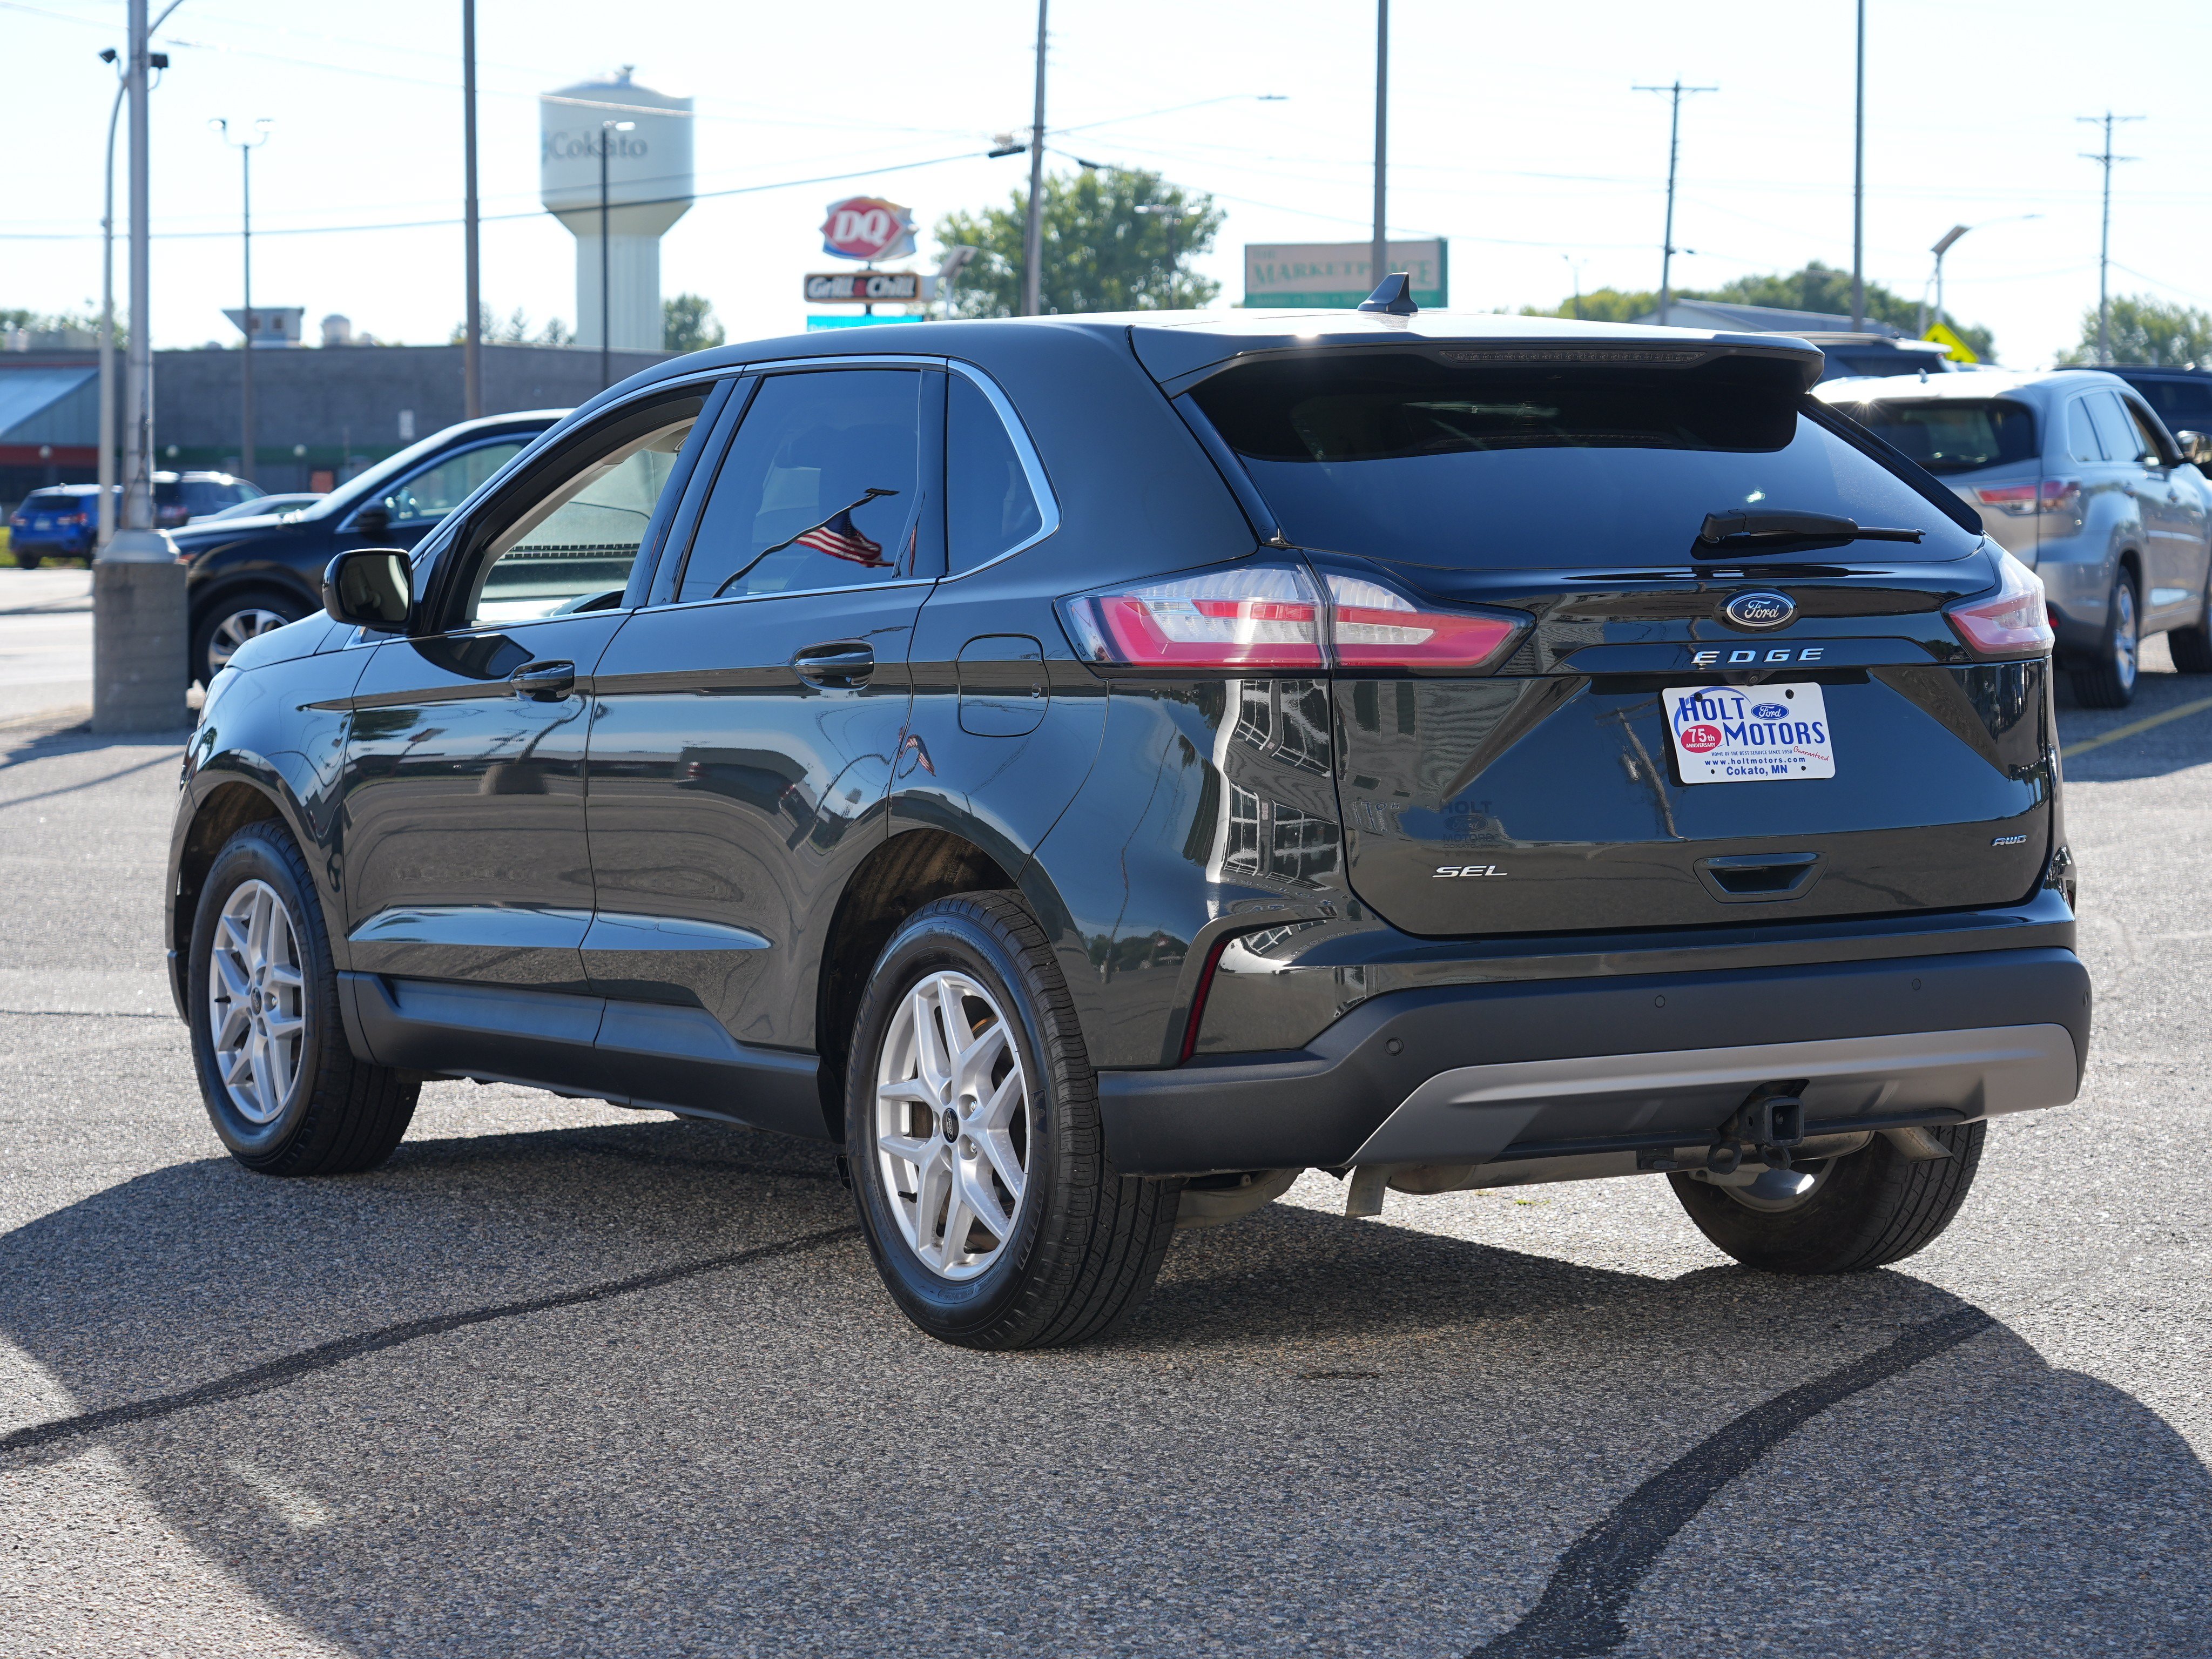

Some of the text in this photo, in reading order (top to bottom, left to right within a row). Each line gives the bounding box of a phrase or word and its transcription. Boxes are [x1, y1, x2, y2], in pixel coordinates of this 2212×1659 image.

[832, 209, 891, 247] DQ
[1252, 259, 1434, 286] MARKETPACE
[807, 275, 916, 297] Grill Chill
[1744, 600, 1779, 618] Ford
[1691, 648, 1824, 664] EDGE
[1678, 697, 1745, 721] HOLT
[1758, 707, 1782, 718] Ford
[1688, 728, 1716, 743] 75th
[1723, 721, 1825, 746] MOTORS
[1793, 745, 1830, 761] Guaranteed
[1704, 757, 1806, 765] www.holtmotors.com
[1726, 765, 1788, 776] Cokato, MN
[1439, 801, 1492, 814] HOLT
[1452, 818, 1479, 829] Ford
[1991, 835, 2027, 846] AWD
[1432, 865, 1508, 878] SEL
